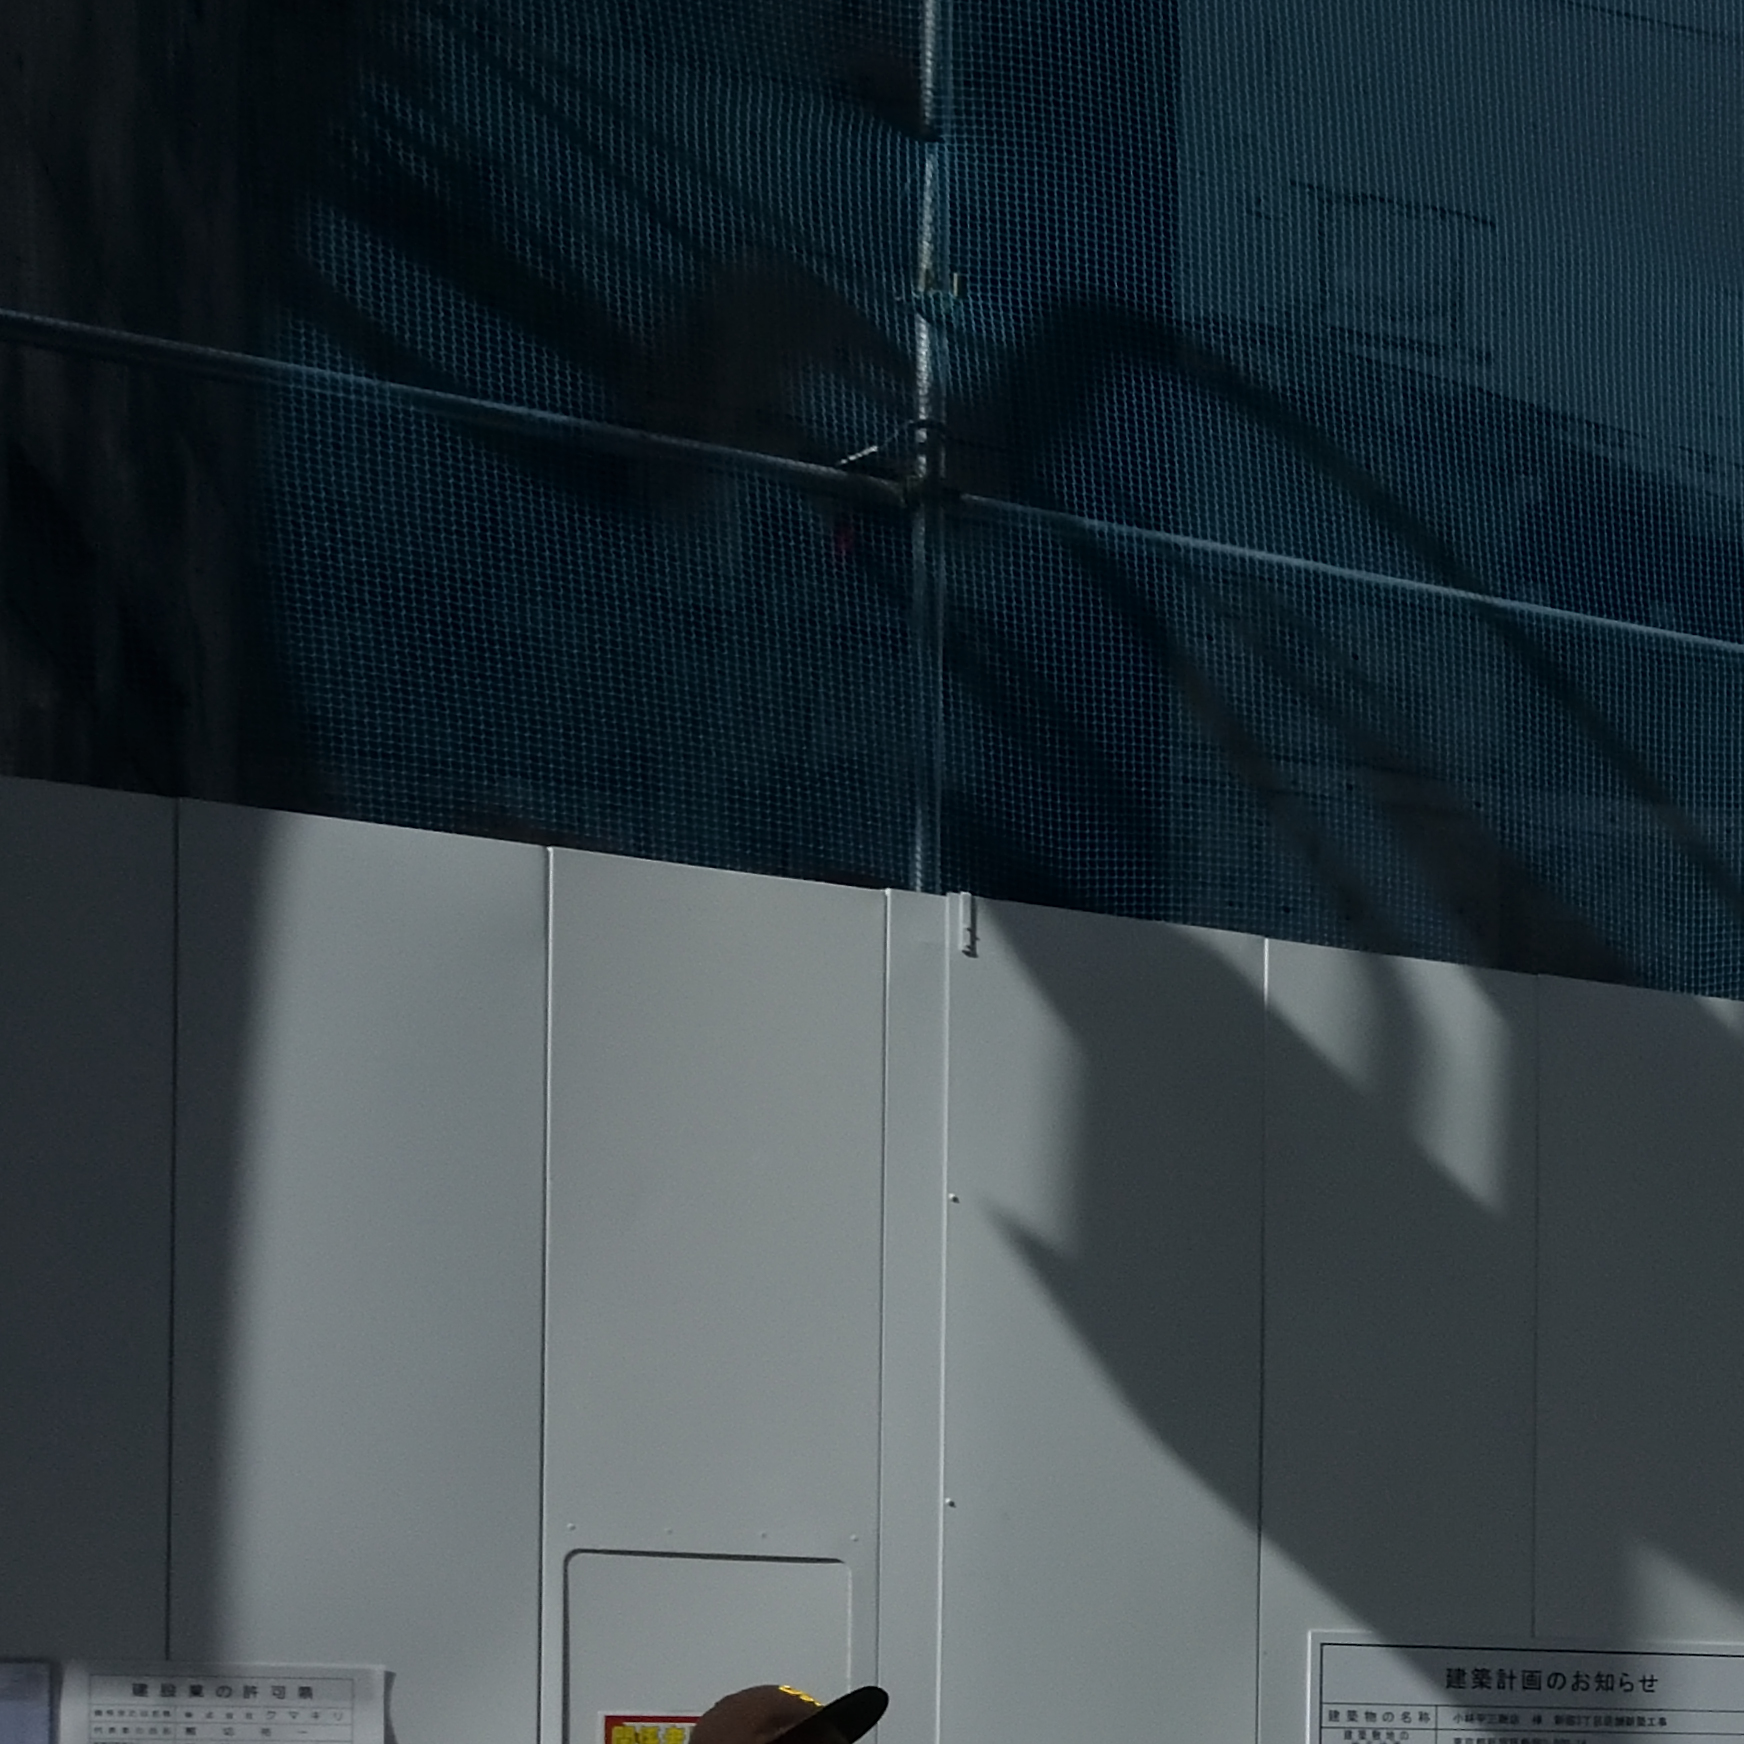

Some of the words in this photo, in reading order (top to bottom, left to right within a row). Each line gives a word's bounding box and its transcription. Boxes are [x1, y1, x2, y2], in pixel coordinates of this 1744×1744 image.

[1445, 1666, 1659, 1695] 建築計画のお知らせ
[1328, 1709, 1432, 1725] 建築物の名称
